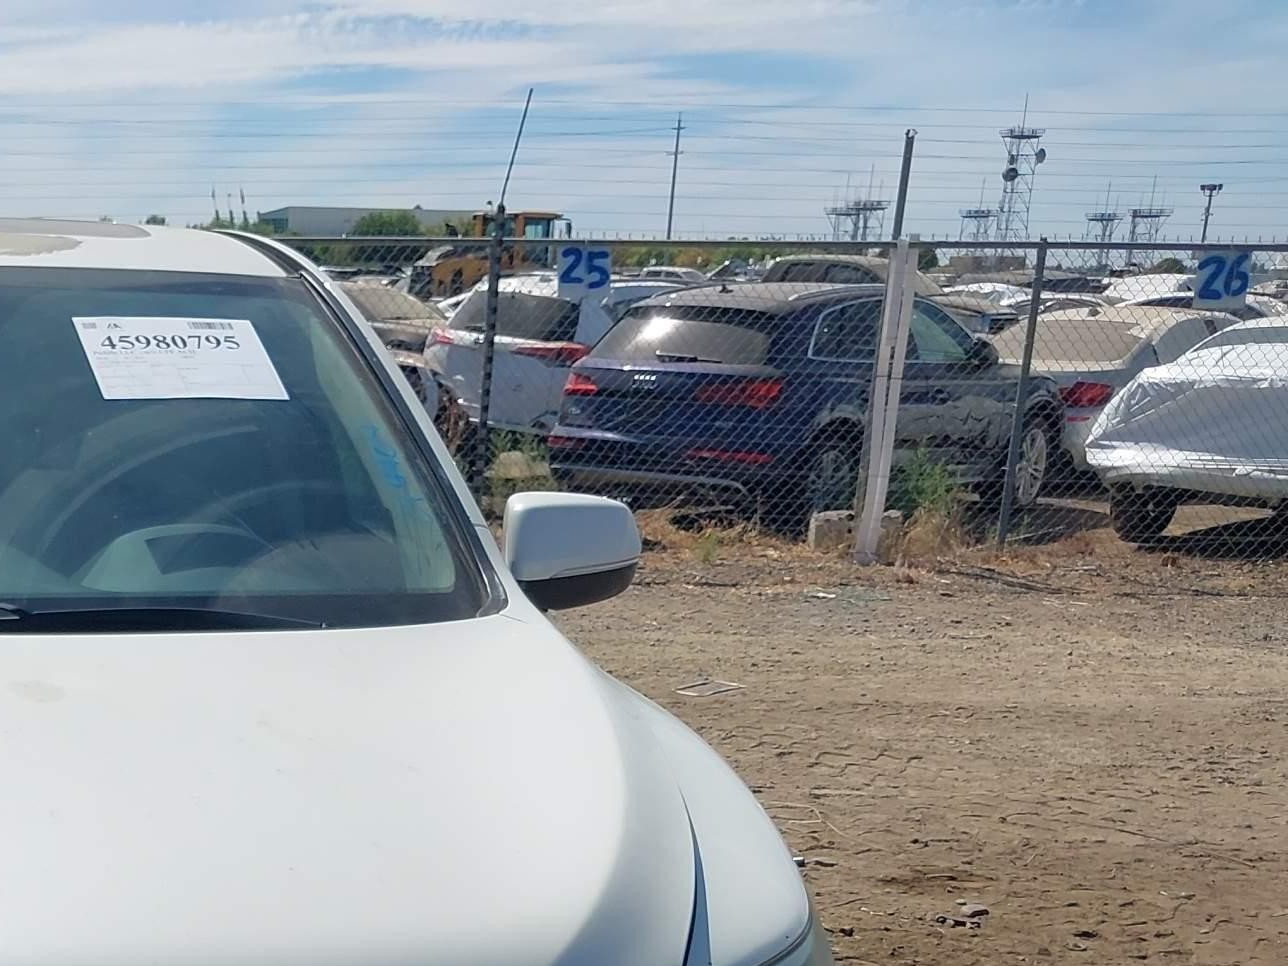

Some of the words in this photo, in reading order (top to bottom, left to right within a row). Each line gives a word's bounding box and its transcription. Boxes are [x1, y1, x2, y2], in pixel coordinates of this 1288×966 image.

[560, 247, 609, 289] 25
[1198, 254, 1249, 299] 26
[101, 334, 240, 350] 45980795
